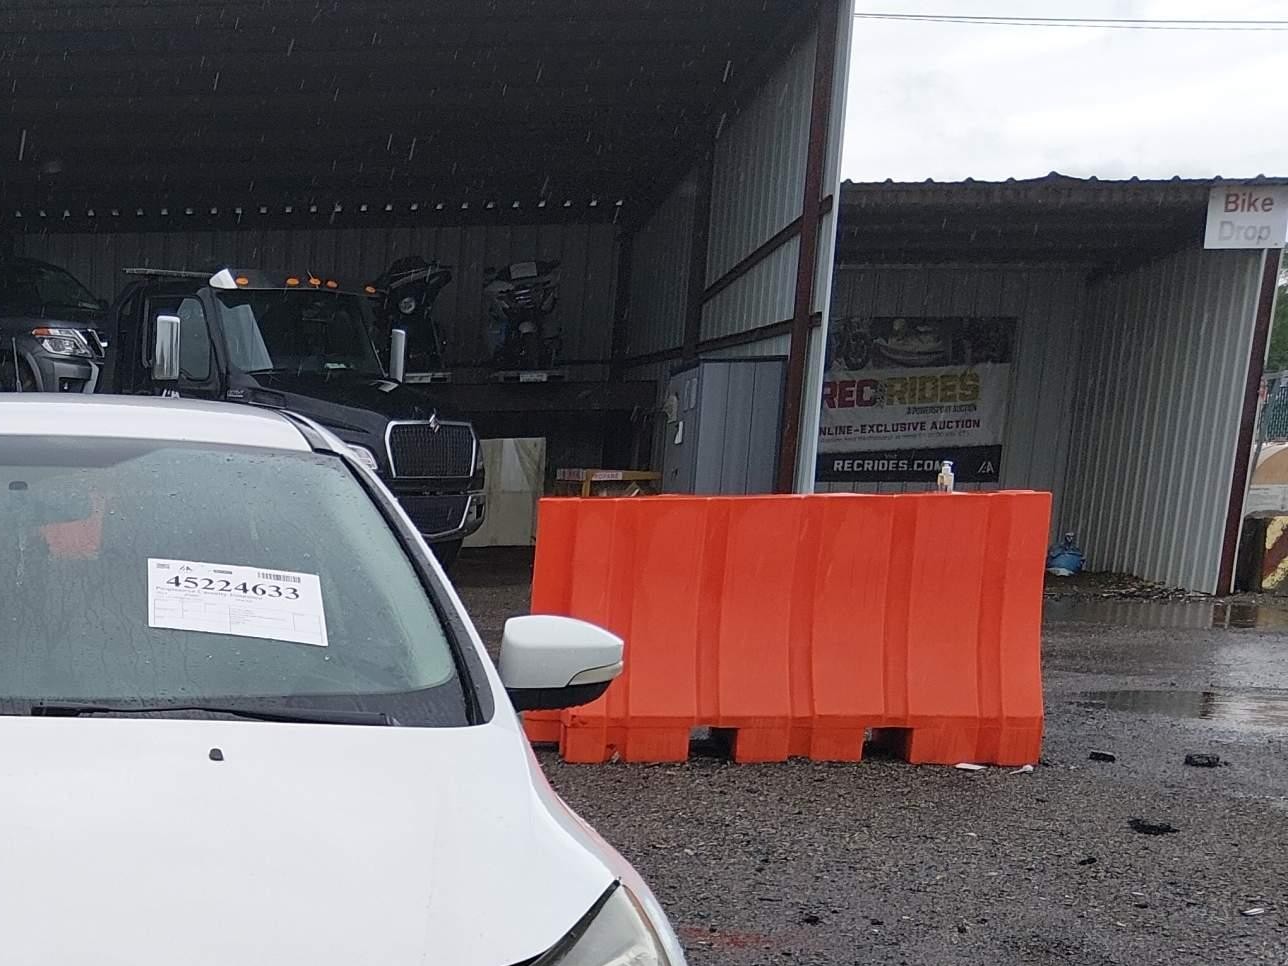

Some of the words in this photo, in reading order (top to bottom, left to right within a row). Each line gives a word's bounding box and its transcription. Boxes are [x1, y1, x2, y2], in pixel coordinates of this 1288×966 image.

[1223, 191, 1275, 213] Bike
[1218, 220, 1272, 246] Drop
[819, 421, 926, 436] NLINE-EXCLUSIVE
[930, 418, 981, 430] AUCTION
[166, 575, 300, 600] 45224633
